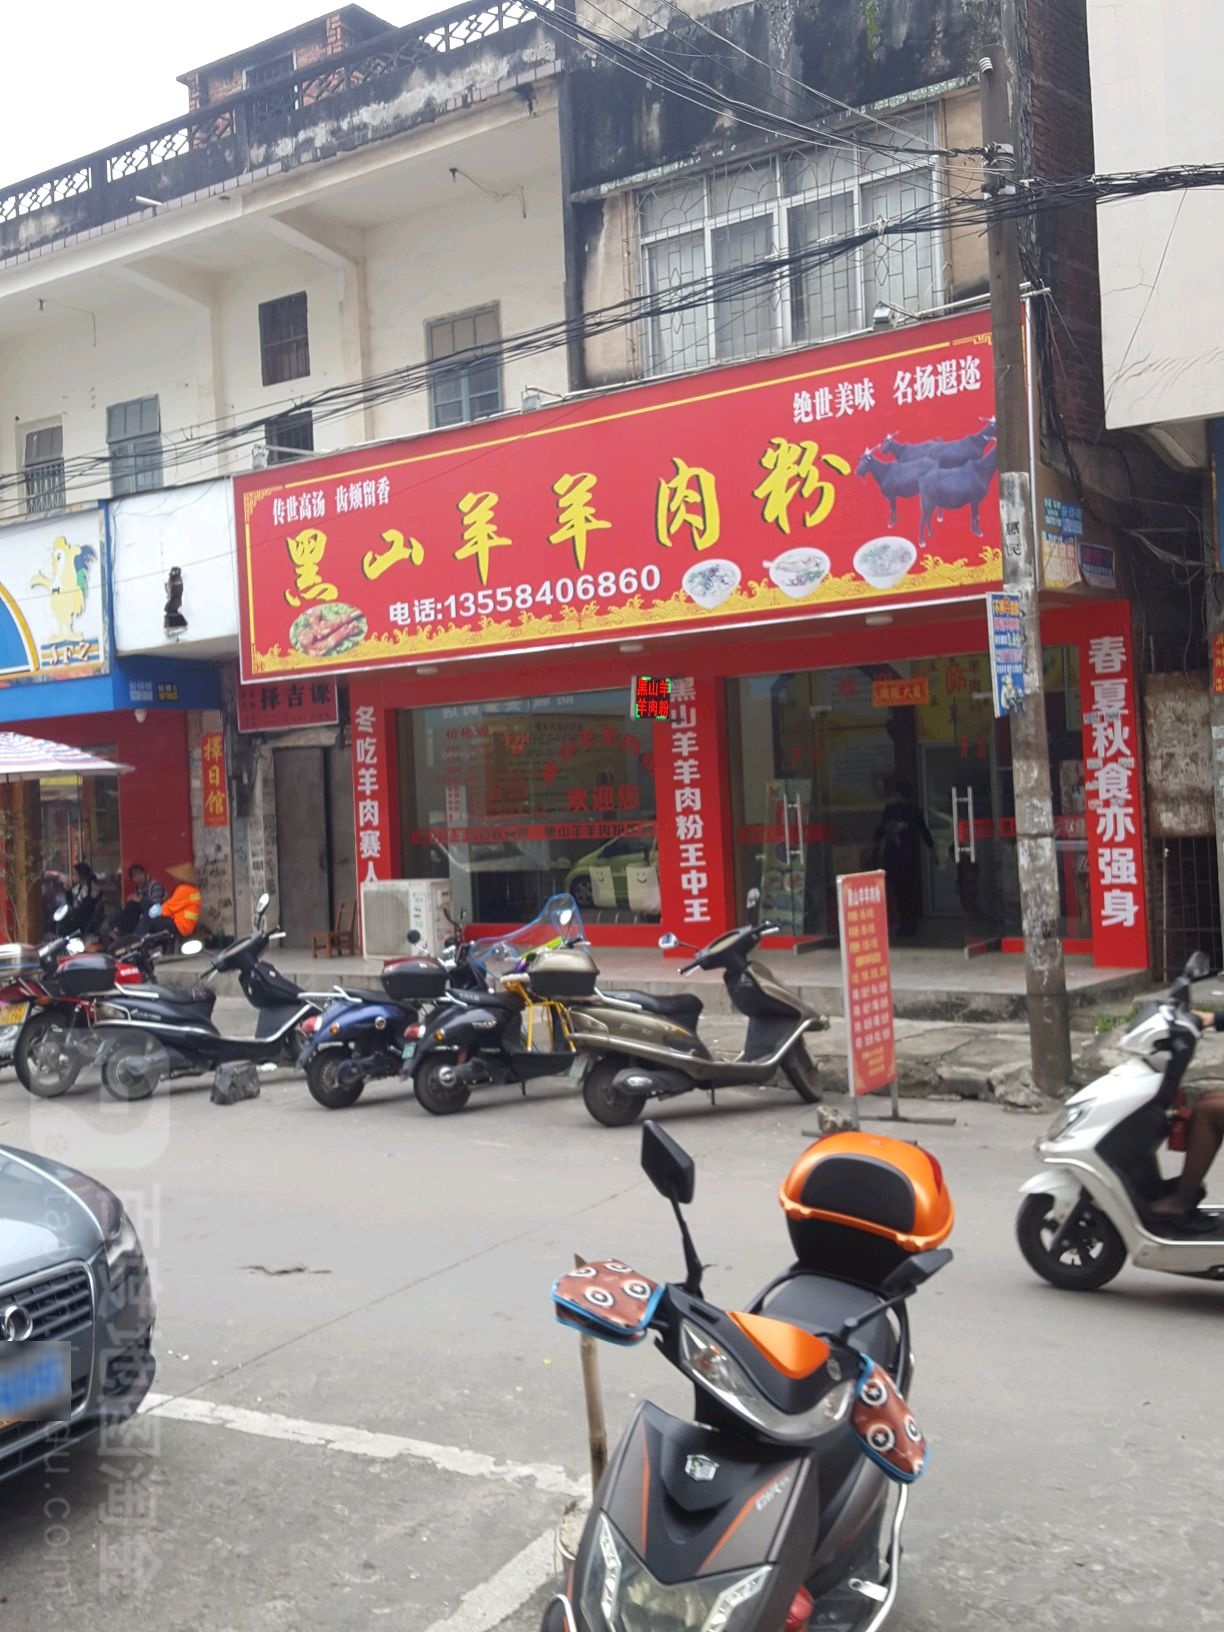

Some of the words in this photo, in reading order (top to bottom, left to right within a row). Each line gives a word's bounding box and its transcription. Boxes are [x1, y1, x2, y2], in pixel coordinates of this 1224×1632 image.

[793, 378, 875, 425] 绝世美味
[893, 355, 982, 407] 名扬遐迩
[272, 489, 326, 527] 传世高汤
[335, 476, 391, 514] 齿颊留香
[284, 436, 852, 607] 黑山羊羊肉粉
[388, 565, 662, 626] 电话:13558406860
[637, 678, 669, 698] 黑山羊
[637, 698, 669, 717] 羊肉粉
[669, 676, 711, 923] 黑山羊羊肉粉王中王
[1088, 636, 1140, 928] 春夏秋食亦强身
